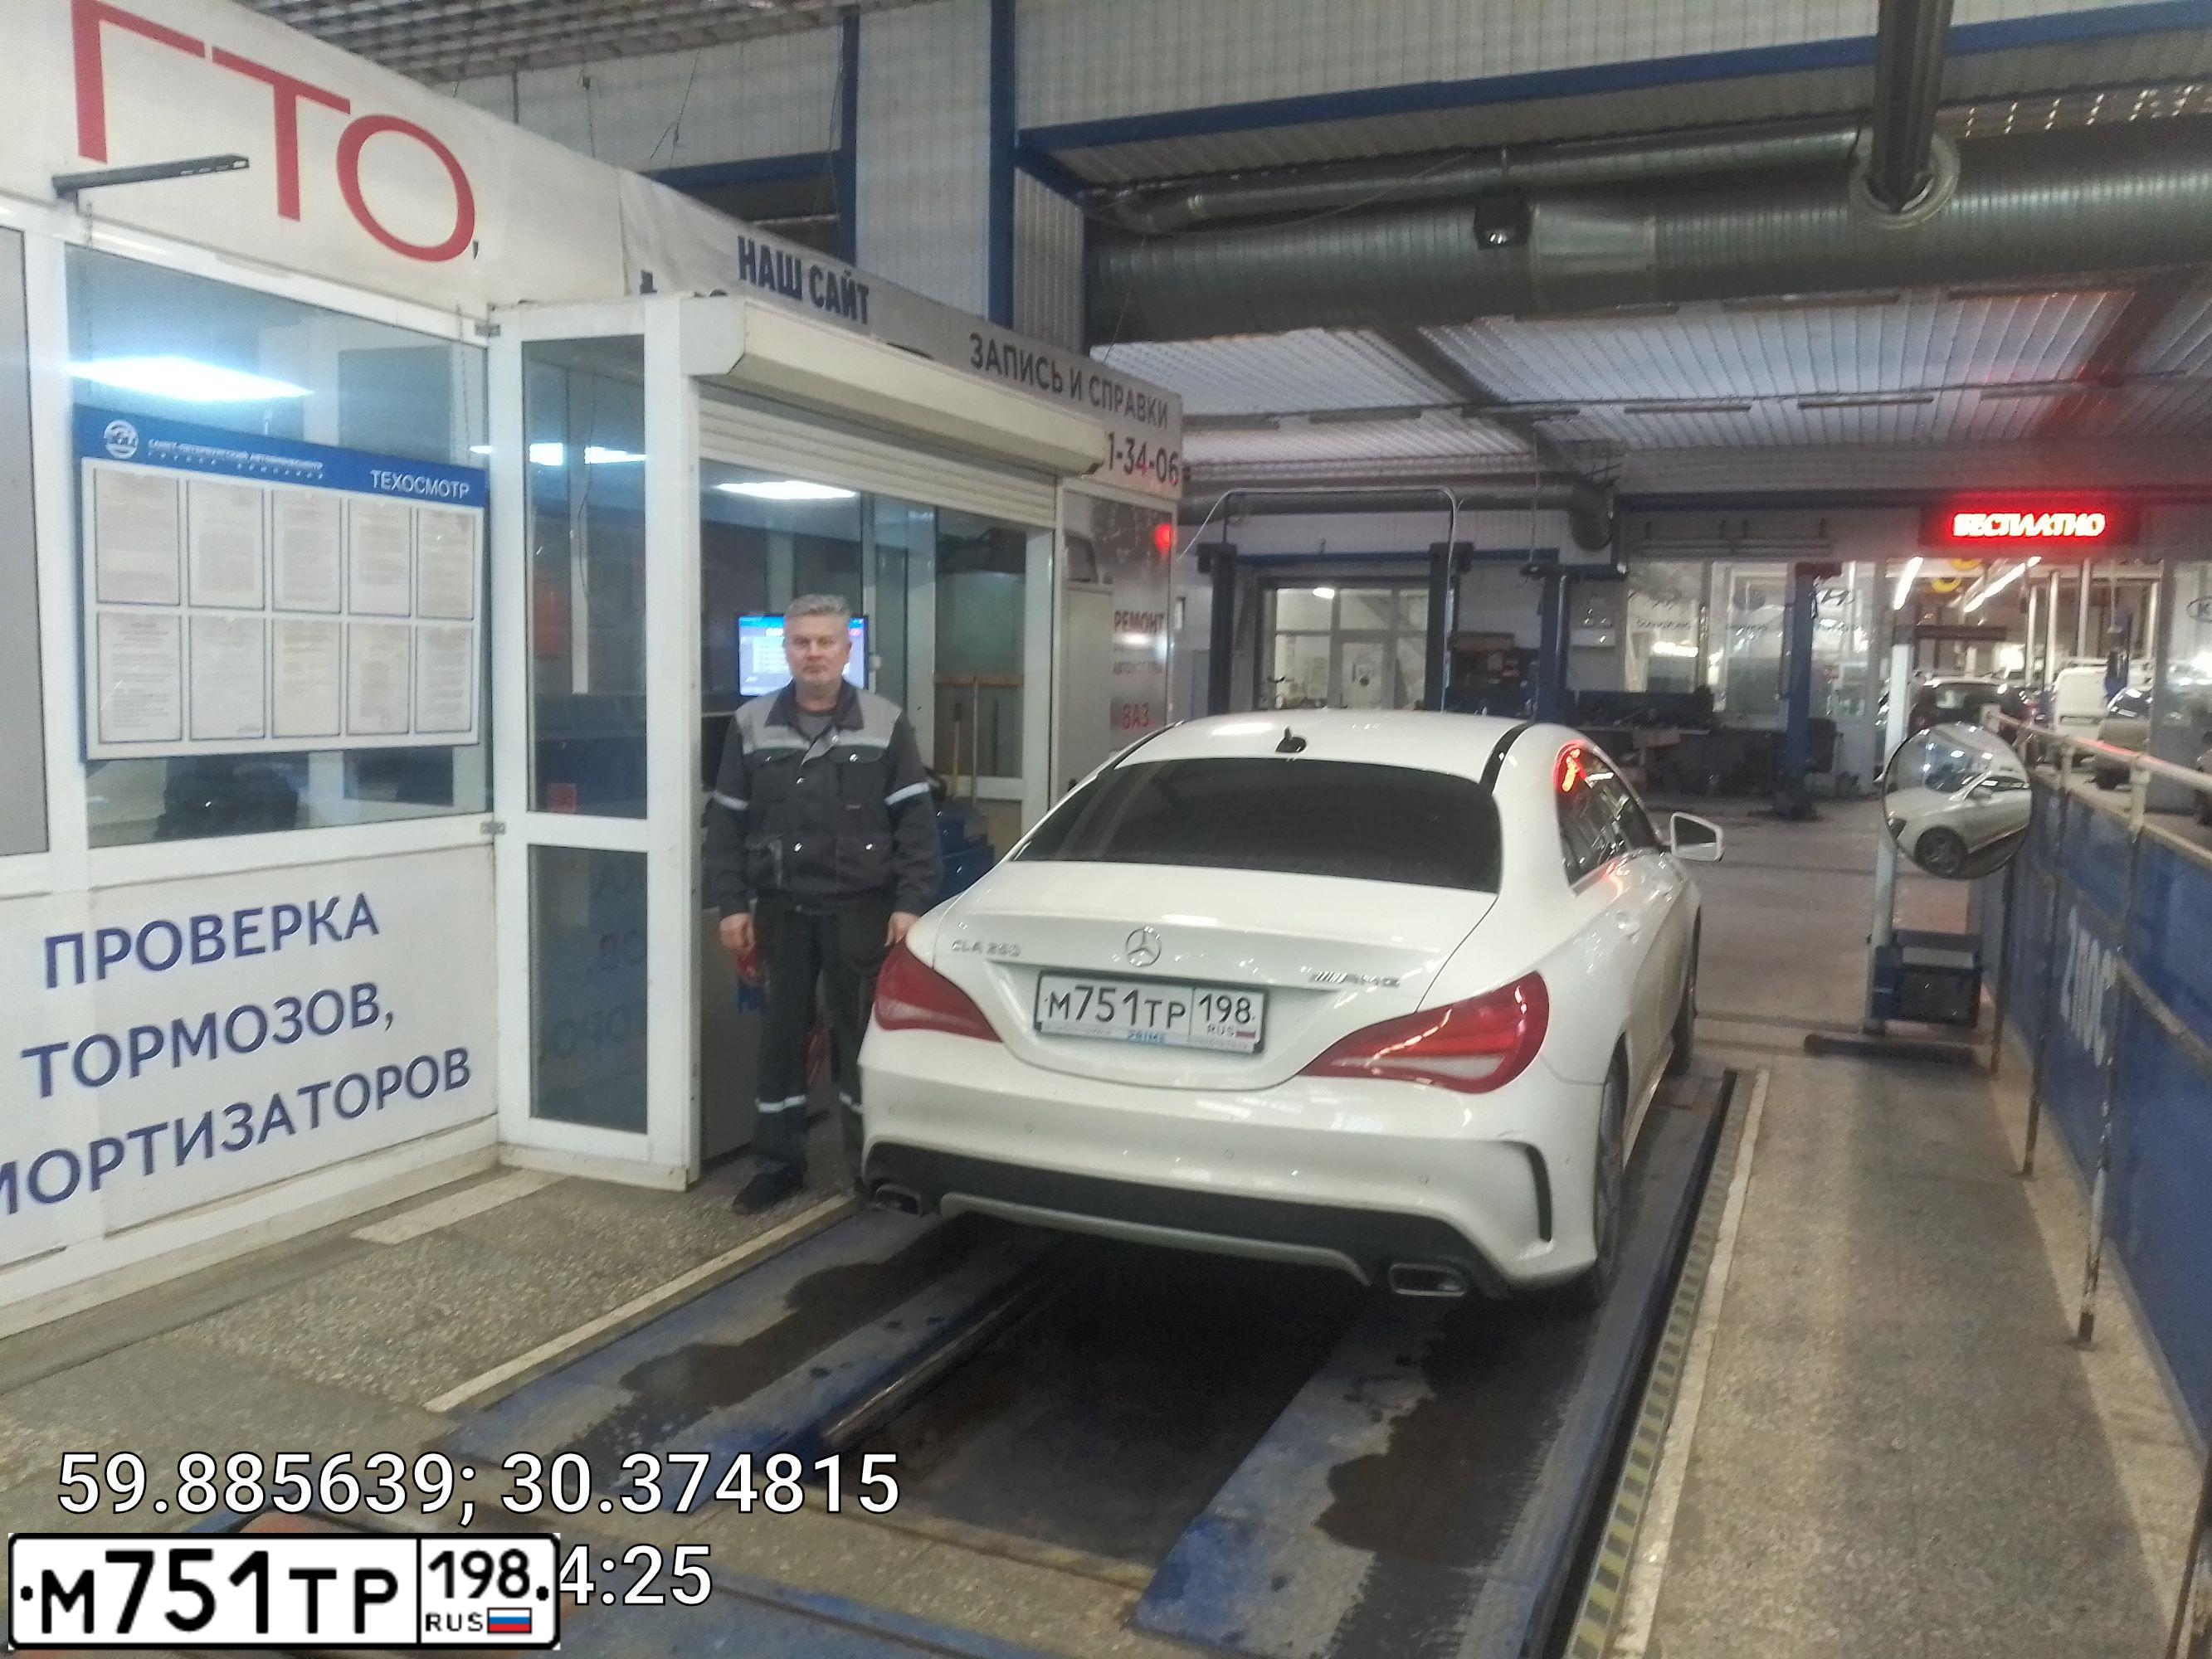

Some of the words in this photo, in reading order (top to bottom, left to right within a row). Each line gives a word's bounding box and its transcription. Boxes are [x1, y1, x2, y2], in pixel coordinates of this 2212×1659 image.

[71, 0, 475, 262] ГТО
[737, 235, 803, 301] НАШ
[808, 263, 870, 324] САЙТ
[969, 332, 1064, 393] ЗАПИСЬ
[1069, 366, 1084, 401] И
[1089, 374, 1168, 431] СПРАВКИ
[370, 469, 470, 499] ТЕХОСМОТР
[44, 892, 380, 990] ПРОВЕРКА
[21, 980, 395, 1099] ТОРМОЗОВ,
[1198, 993, 1251, 1024] 198
